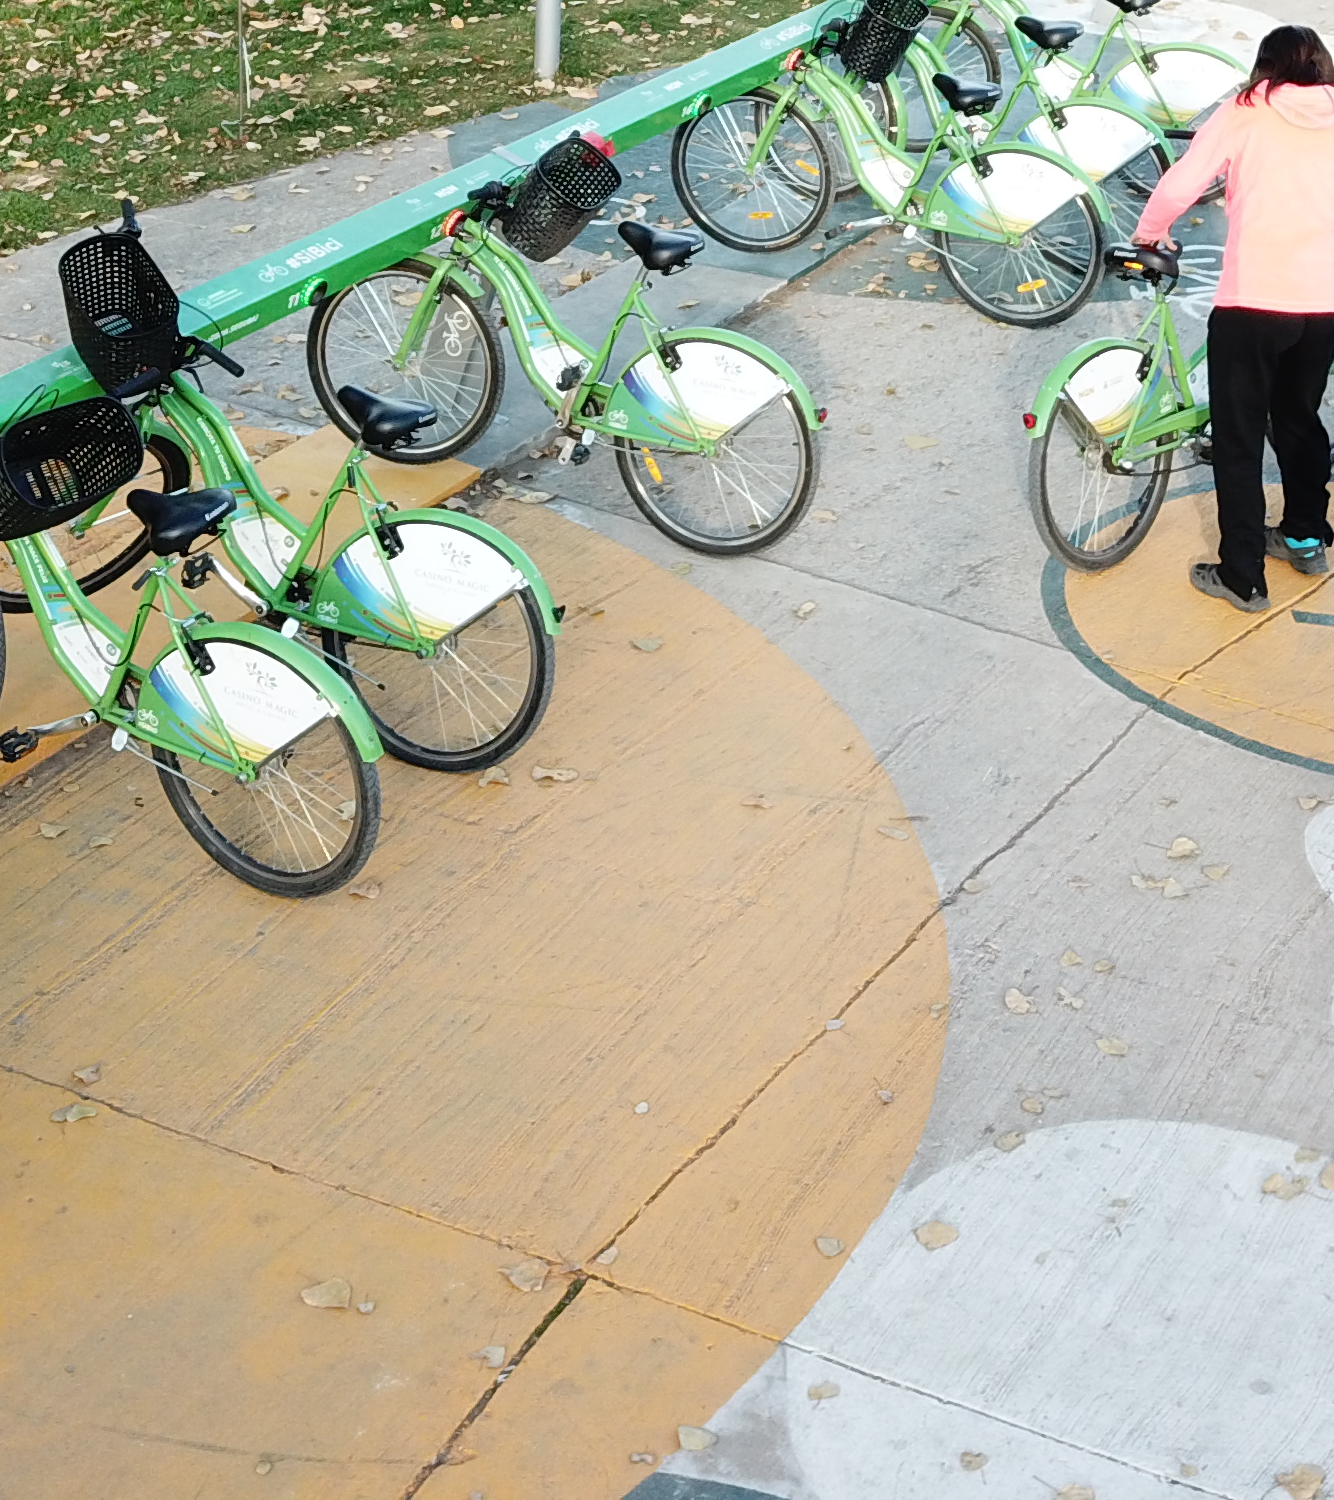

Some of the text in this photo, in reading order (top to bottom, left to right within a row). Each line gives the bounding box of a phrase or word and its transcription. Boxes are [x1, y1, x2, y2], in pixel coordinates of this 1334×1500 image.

[286, 237, 344, 269] #SiBici
[414, 568, 491, 594] CASINO MAGIC
[224, 686, 300, 719] CASINO MAGIC
